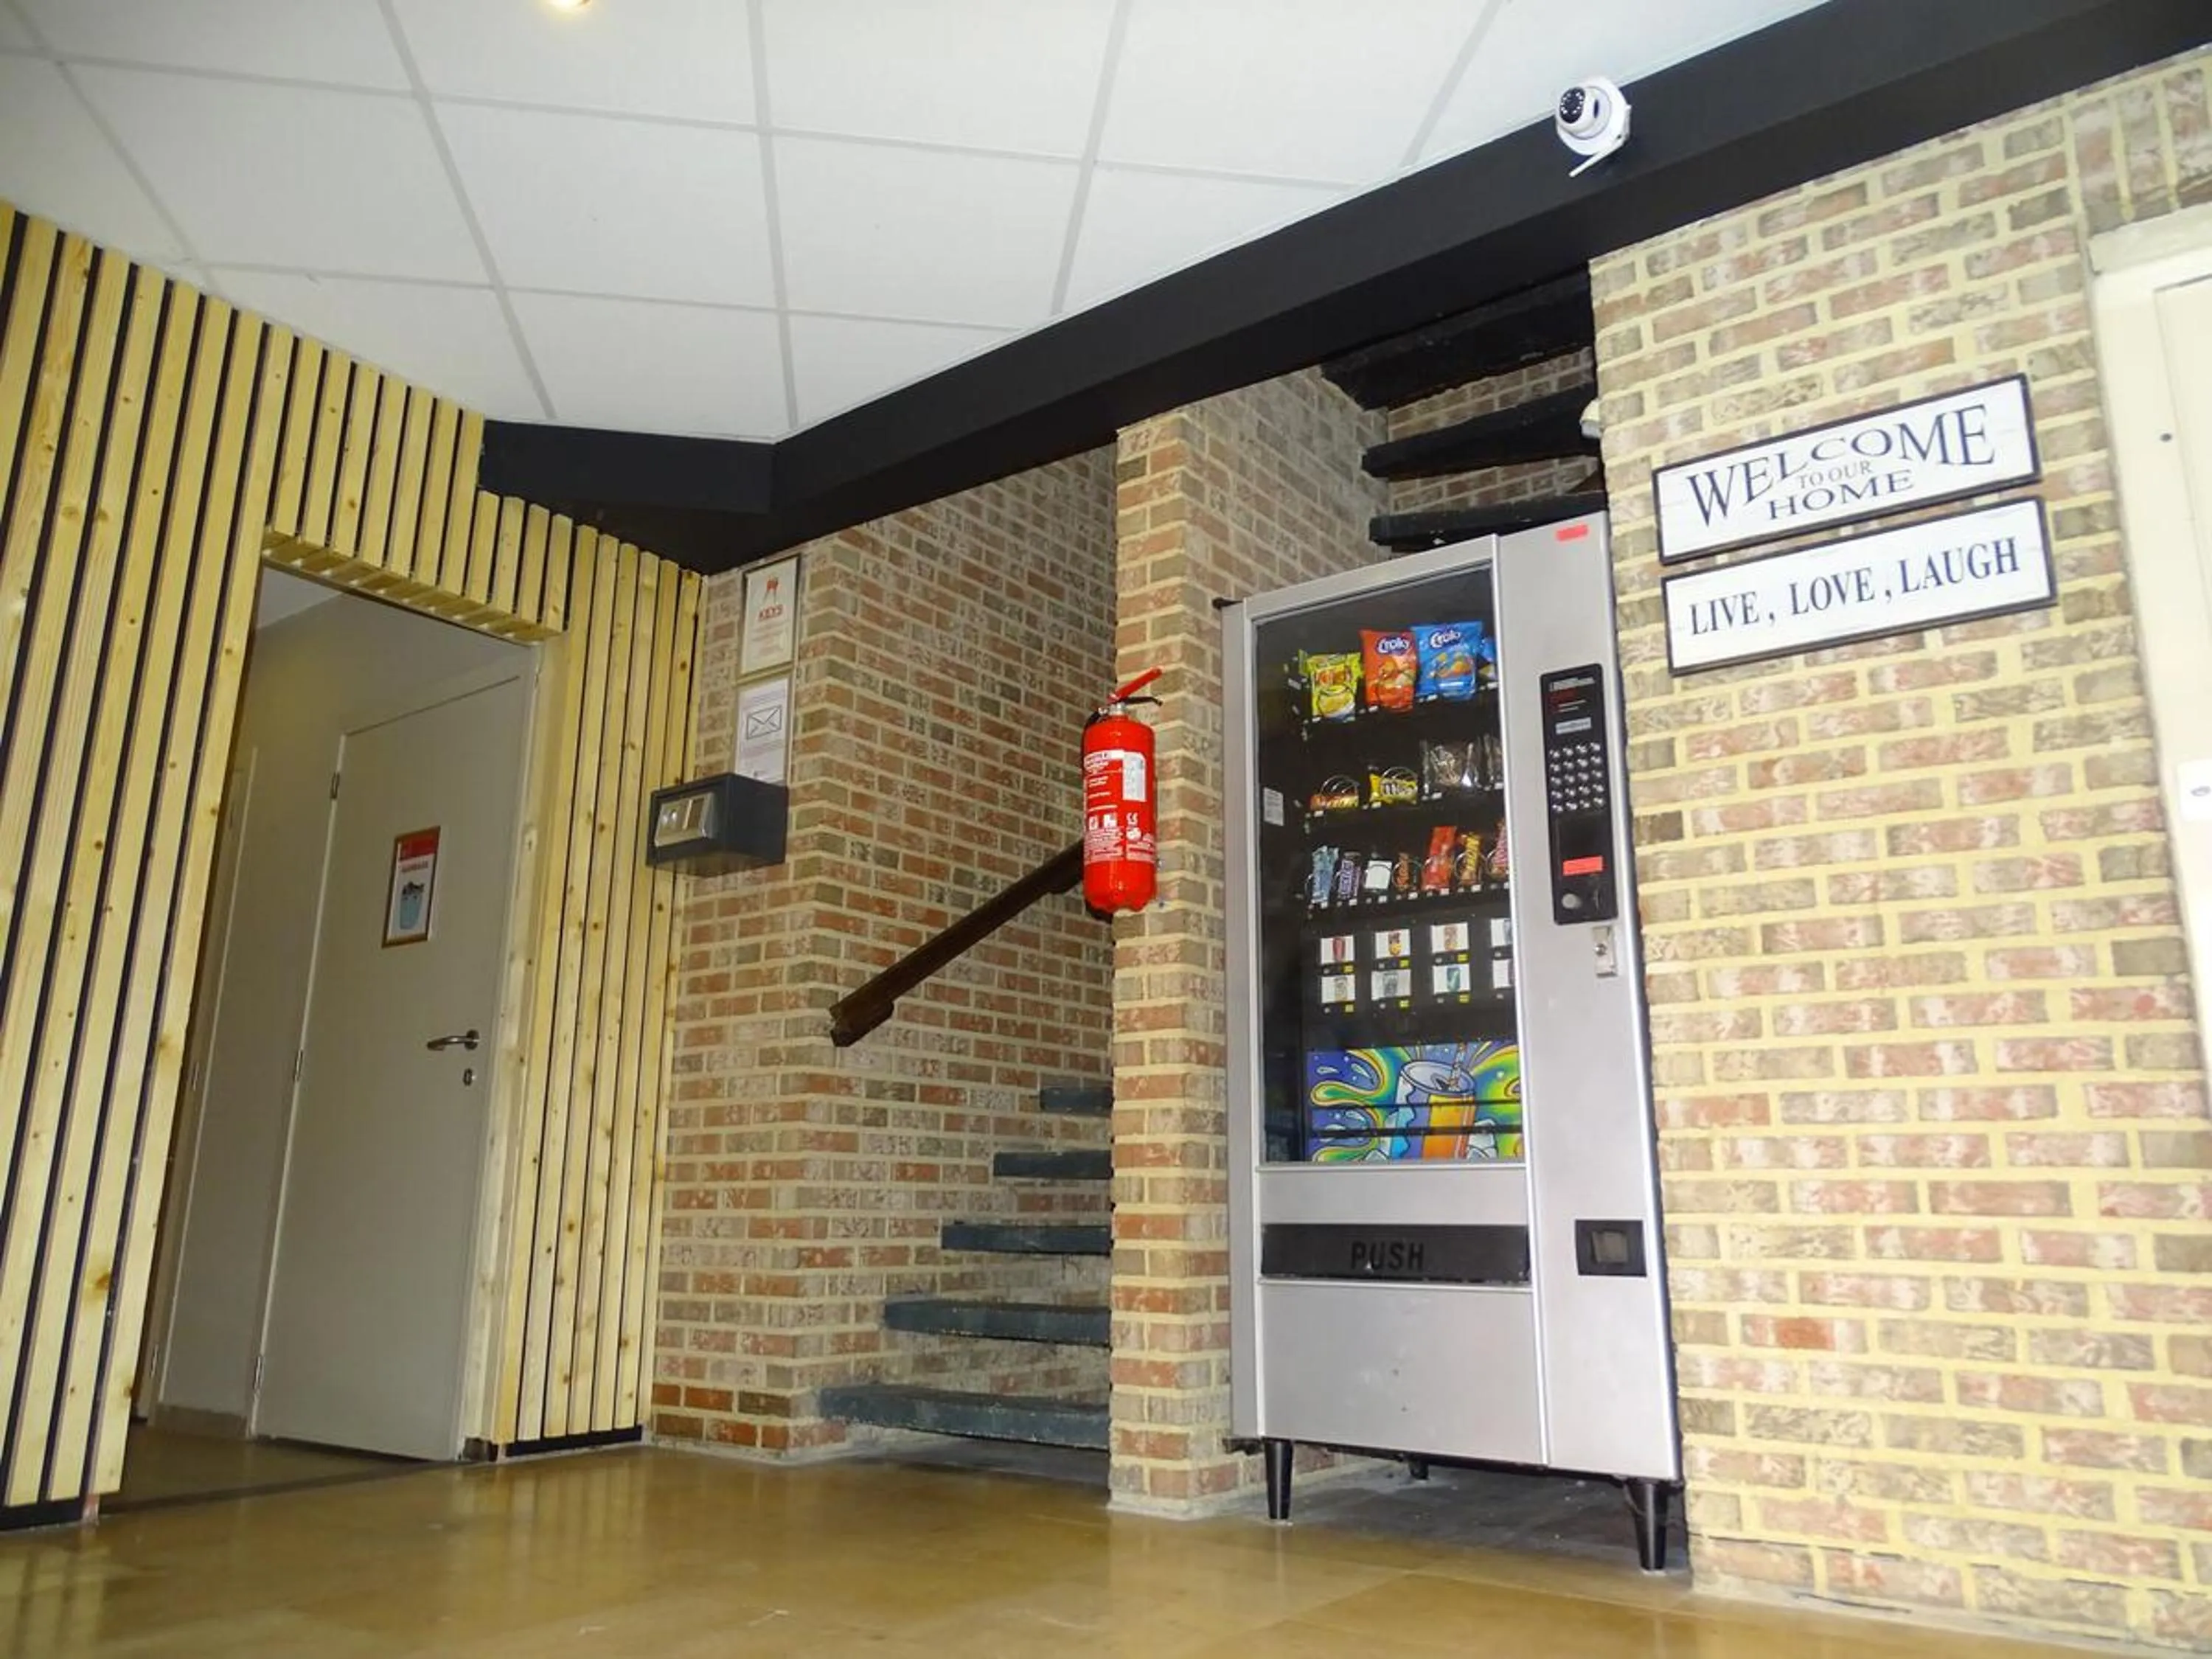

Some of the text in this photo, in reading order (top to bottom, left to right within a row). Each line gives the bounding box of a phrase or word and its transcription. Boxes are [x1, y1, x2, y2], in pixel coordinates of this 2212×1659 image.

[1686, 404, 1995, 528] WELCOME
[1799, 460, 1874, 490] TO OUR
[1769, 469, 1916, 519] HOME
[1689, 537, 2020, 636] LIVE, LOVE, LAUGH
[1351, 1241, 1425, 1270] PUSH
